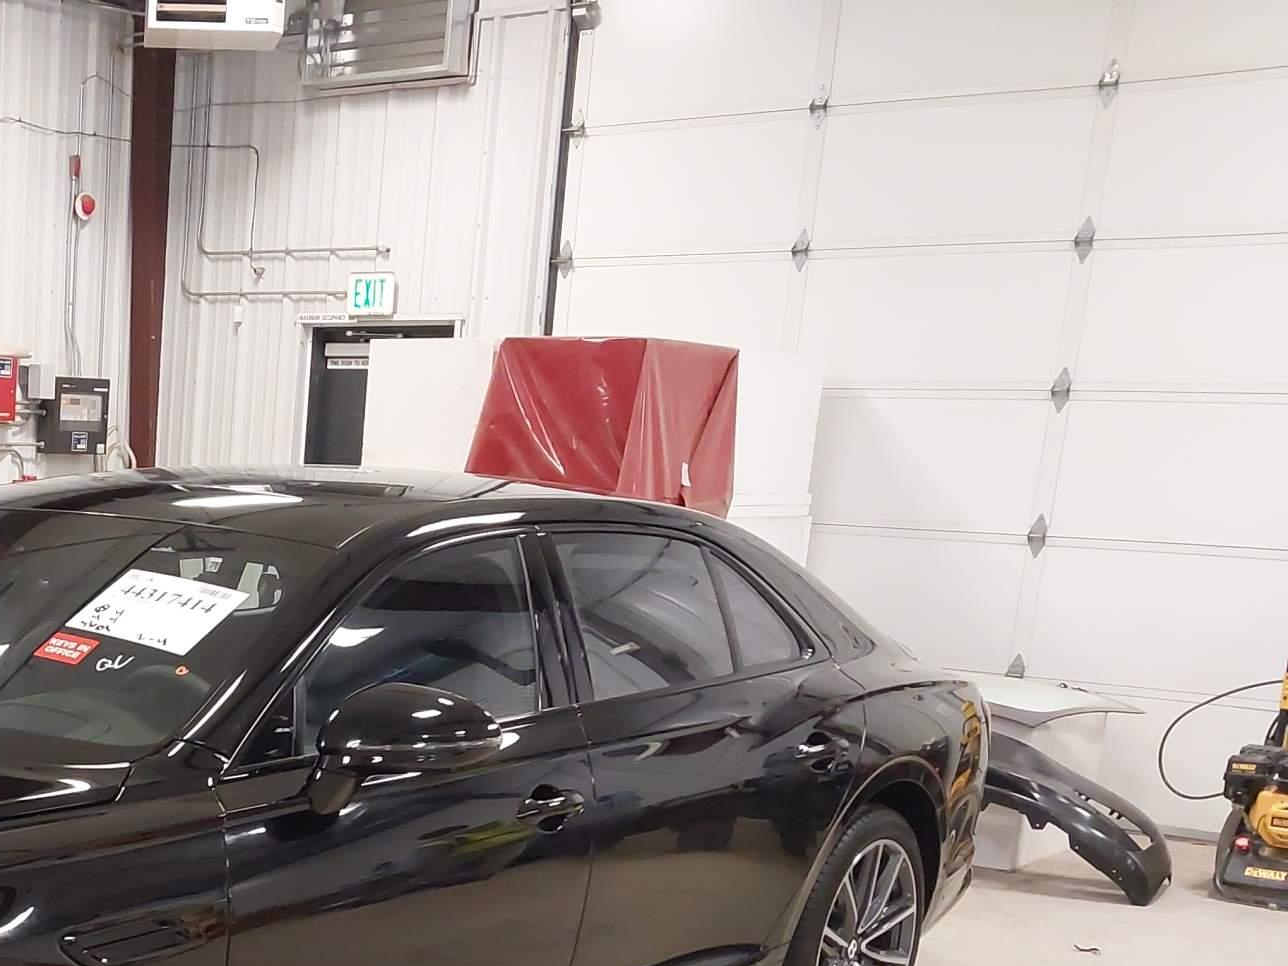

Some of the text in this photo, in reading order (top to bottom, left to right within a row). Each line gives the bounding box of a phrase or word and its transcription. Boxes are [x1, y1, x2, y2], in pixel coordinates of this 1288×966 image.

[354, 278, 386, 308] EXIT
[120, 584, 217, 614] 44317414
[44, 645, 82, 659] OFFICE
[49, 638, 92, 652] KEYS IN
